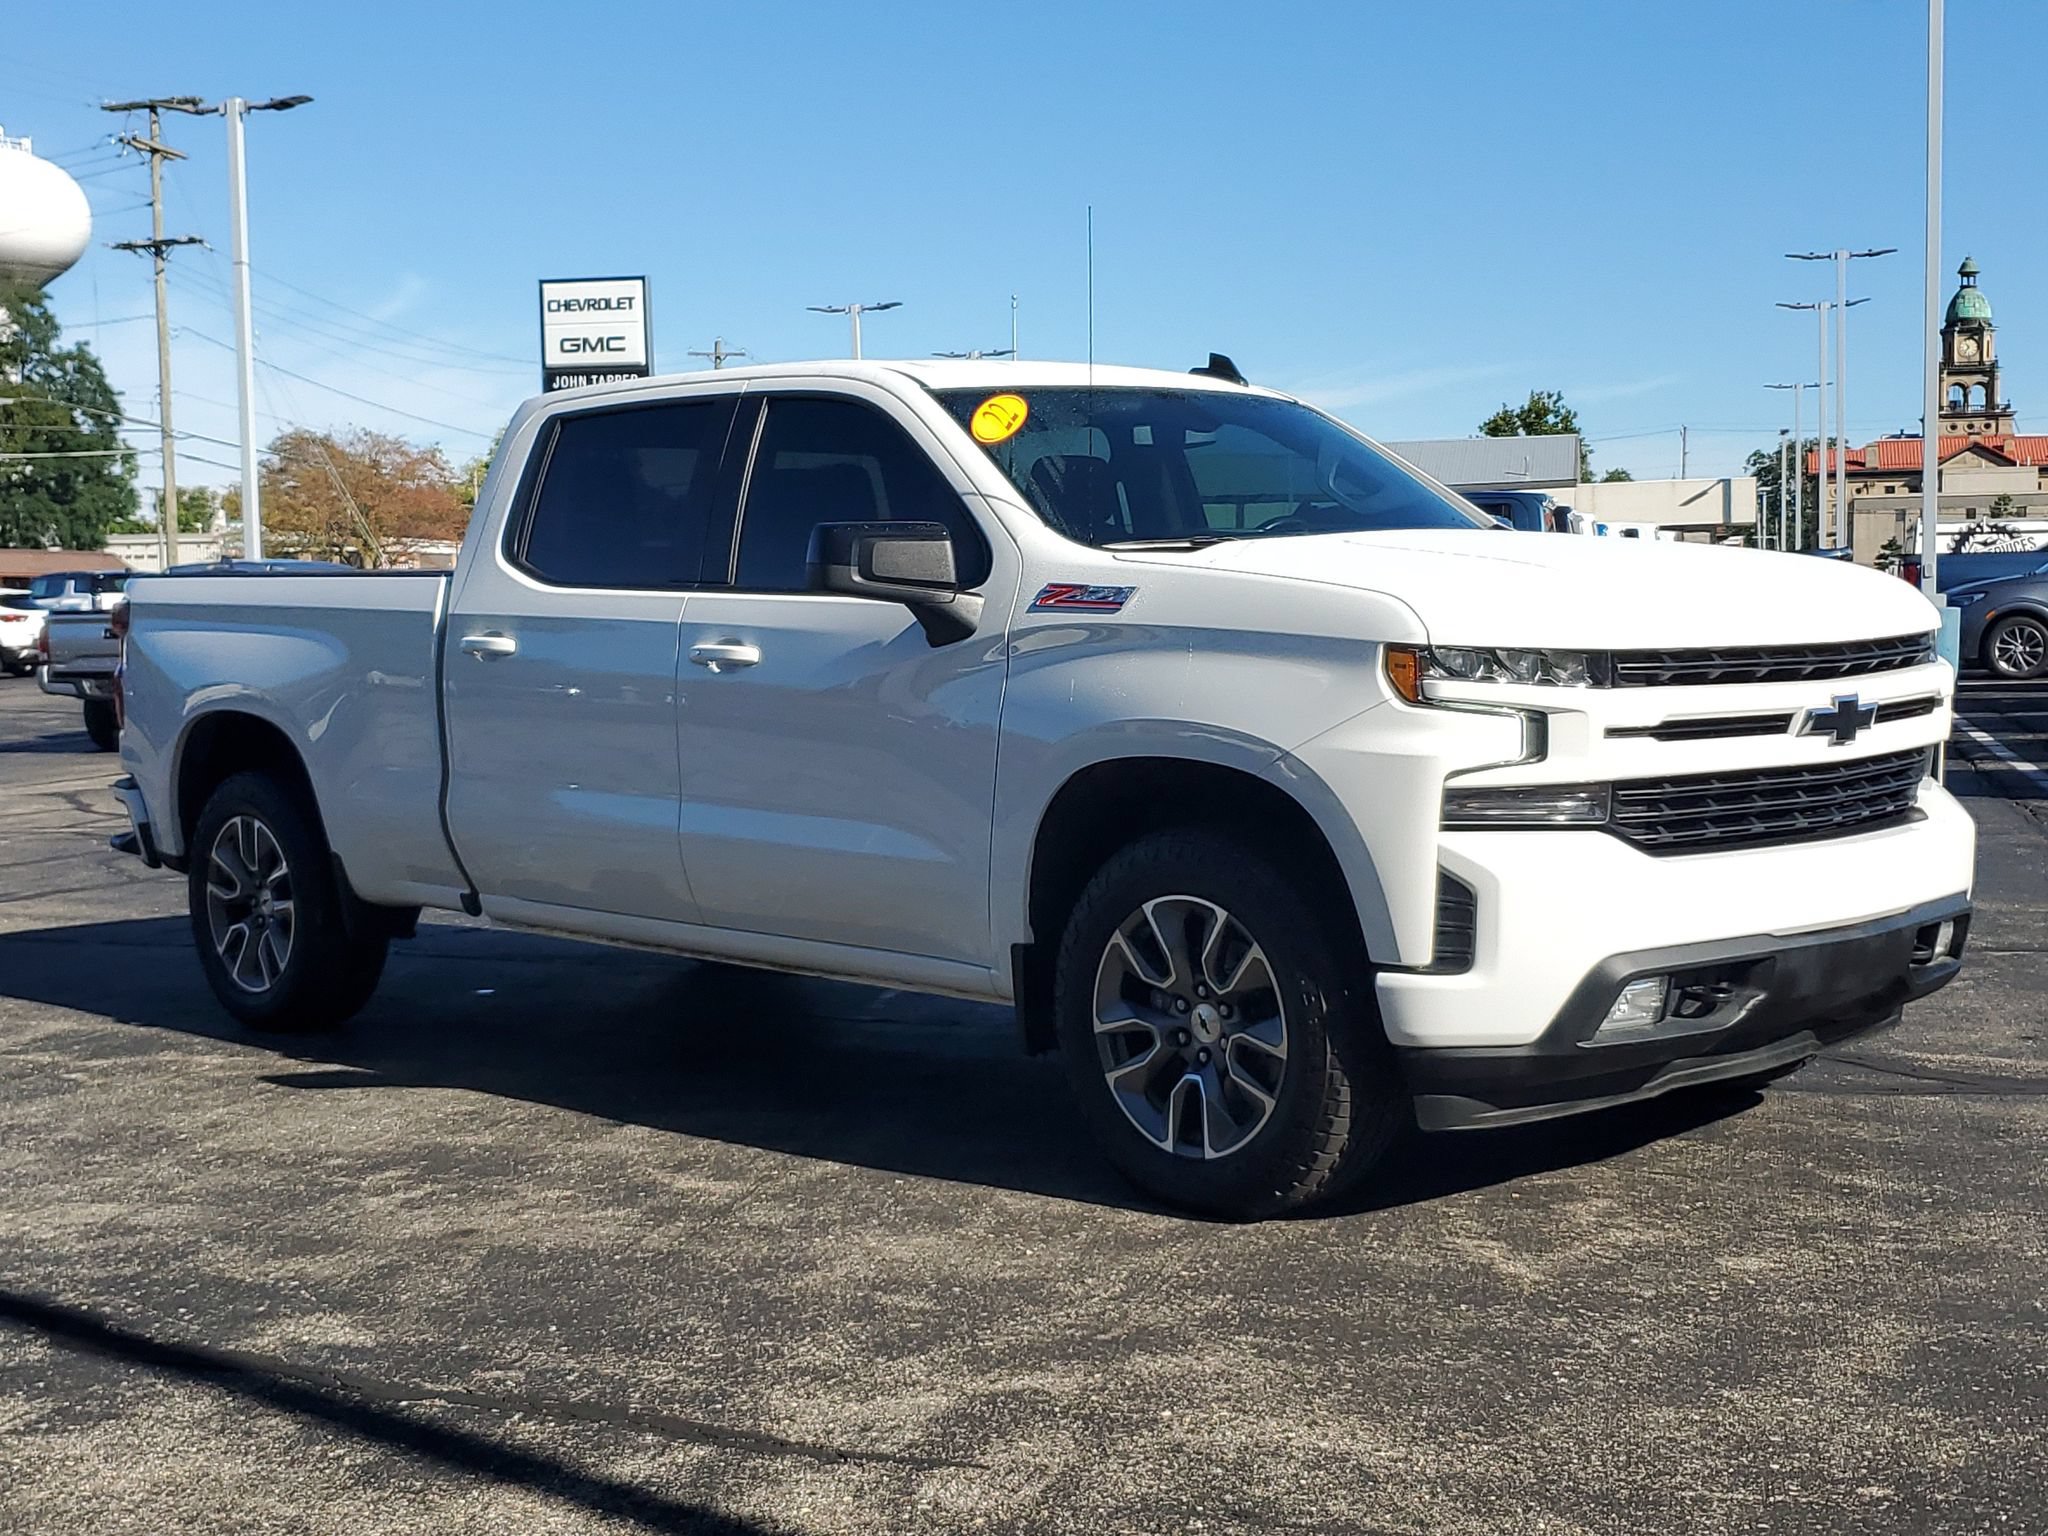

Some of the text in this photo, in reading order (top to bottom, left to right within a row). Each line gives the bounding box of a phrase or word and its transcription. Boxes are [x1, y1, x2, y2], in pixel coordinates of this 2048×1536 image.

[547, 296, 635, 312] CHEVROLET
[560, 336, 626, 353] GMC
[552, 375, 587, 389] JOHN
